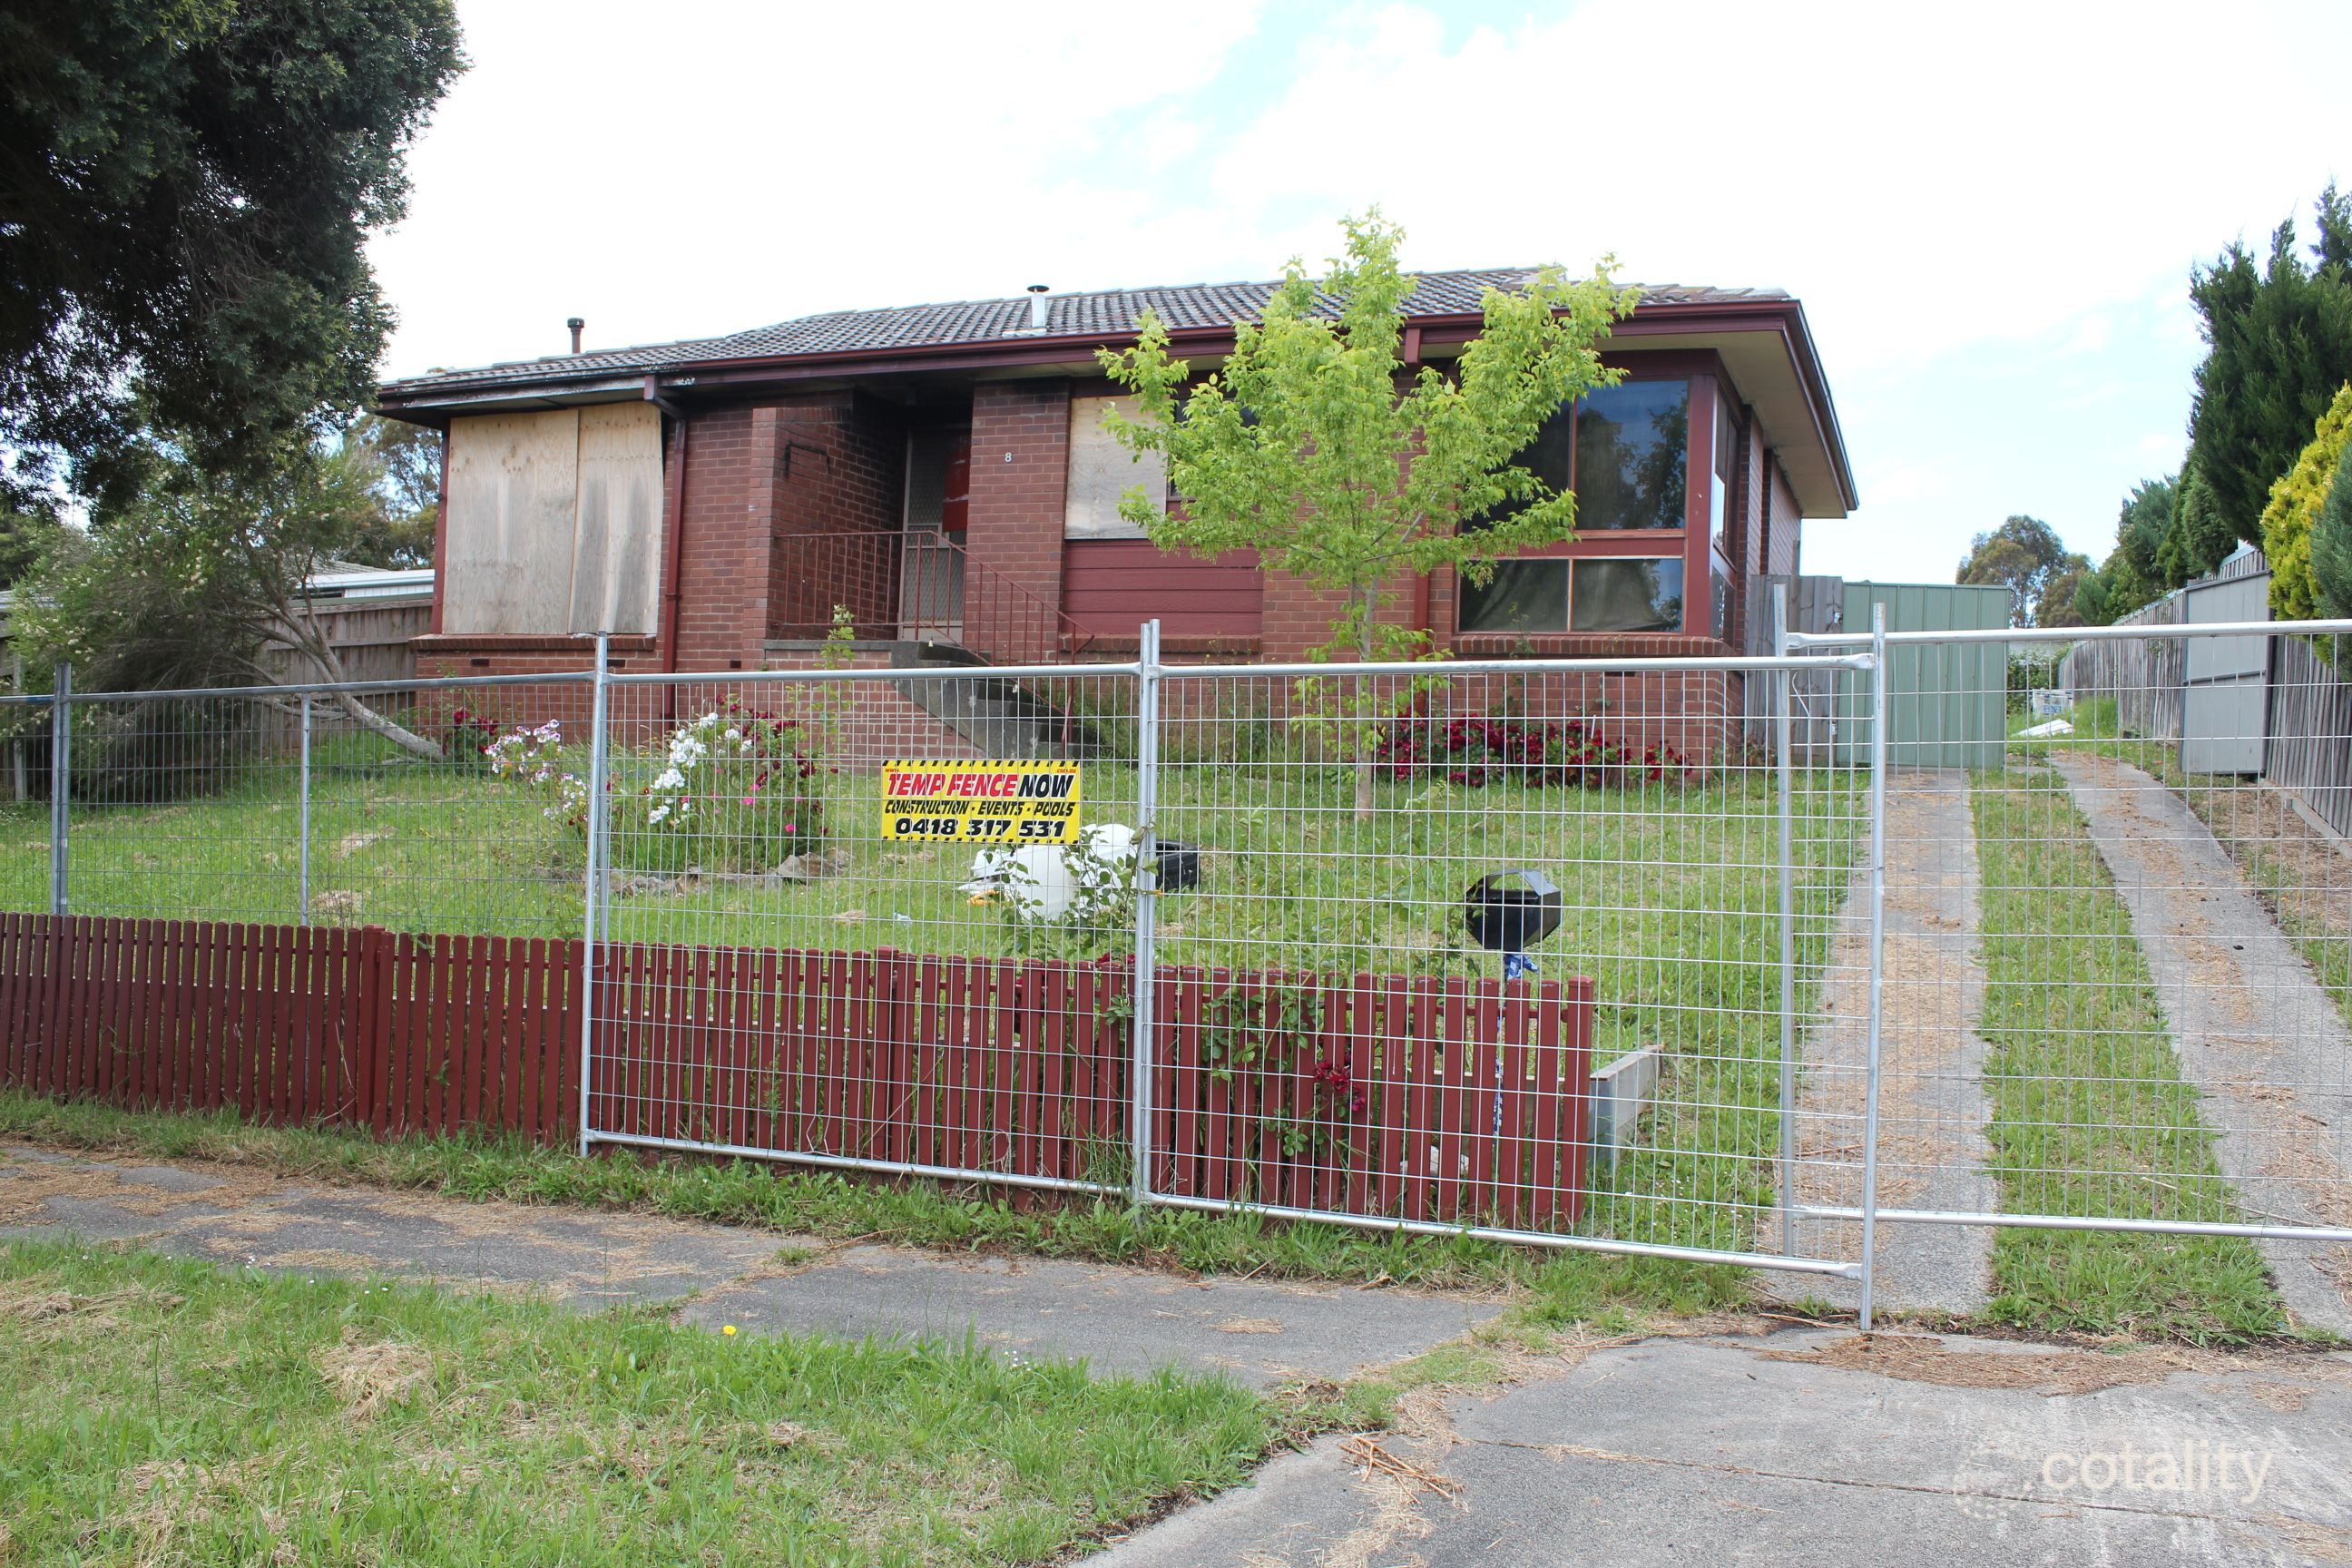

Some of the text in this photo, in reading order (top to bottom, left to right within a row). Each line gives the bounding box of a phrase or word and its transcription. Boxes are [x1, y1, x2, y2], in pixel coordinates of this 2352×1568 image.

[1004, 452, 1013, 463] 8
[887, 773, 1075, 799] TEMP FENCE NOW
[885, 799, 1075, 817] CONSTRUCTION EVENTS POOLS
[896, 818, 1065, 837] 0418 317 531
